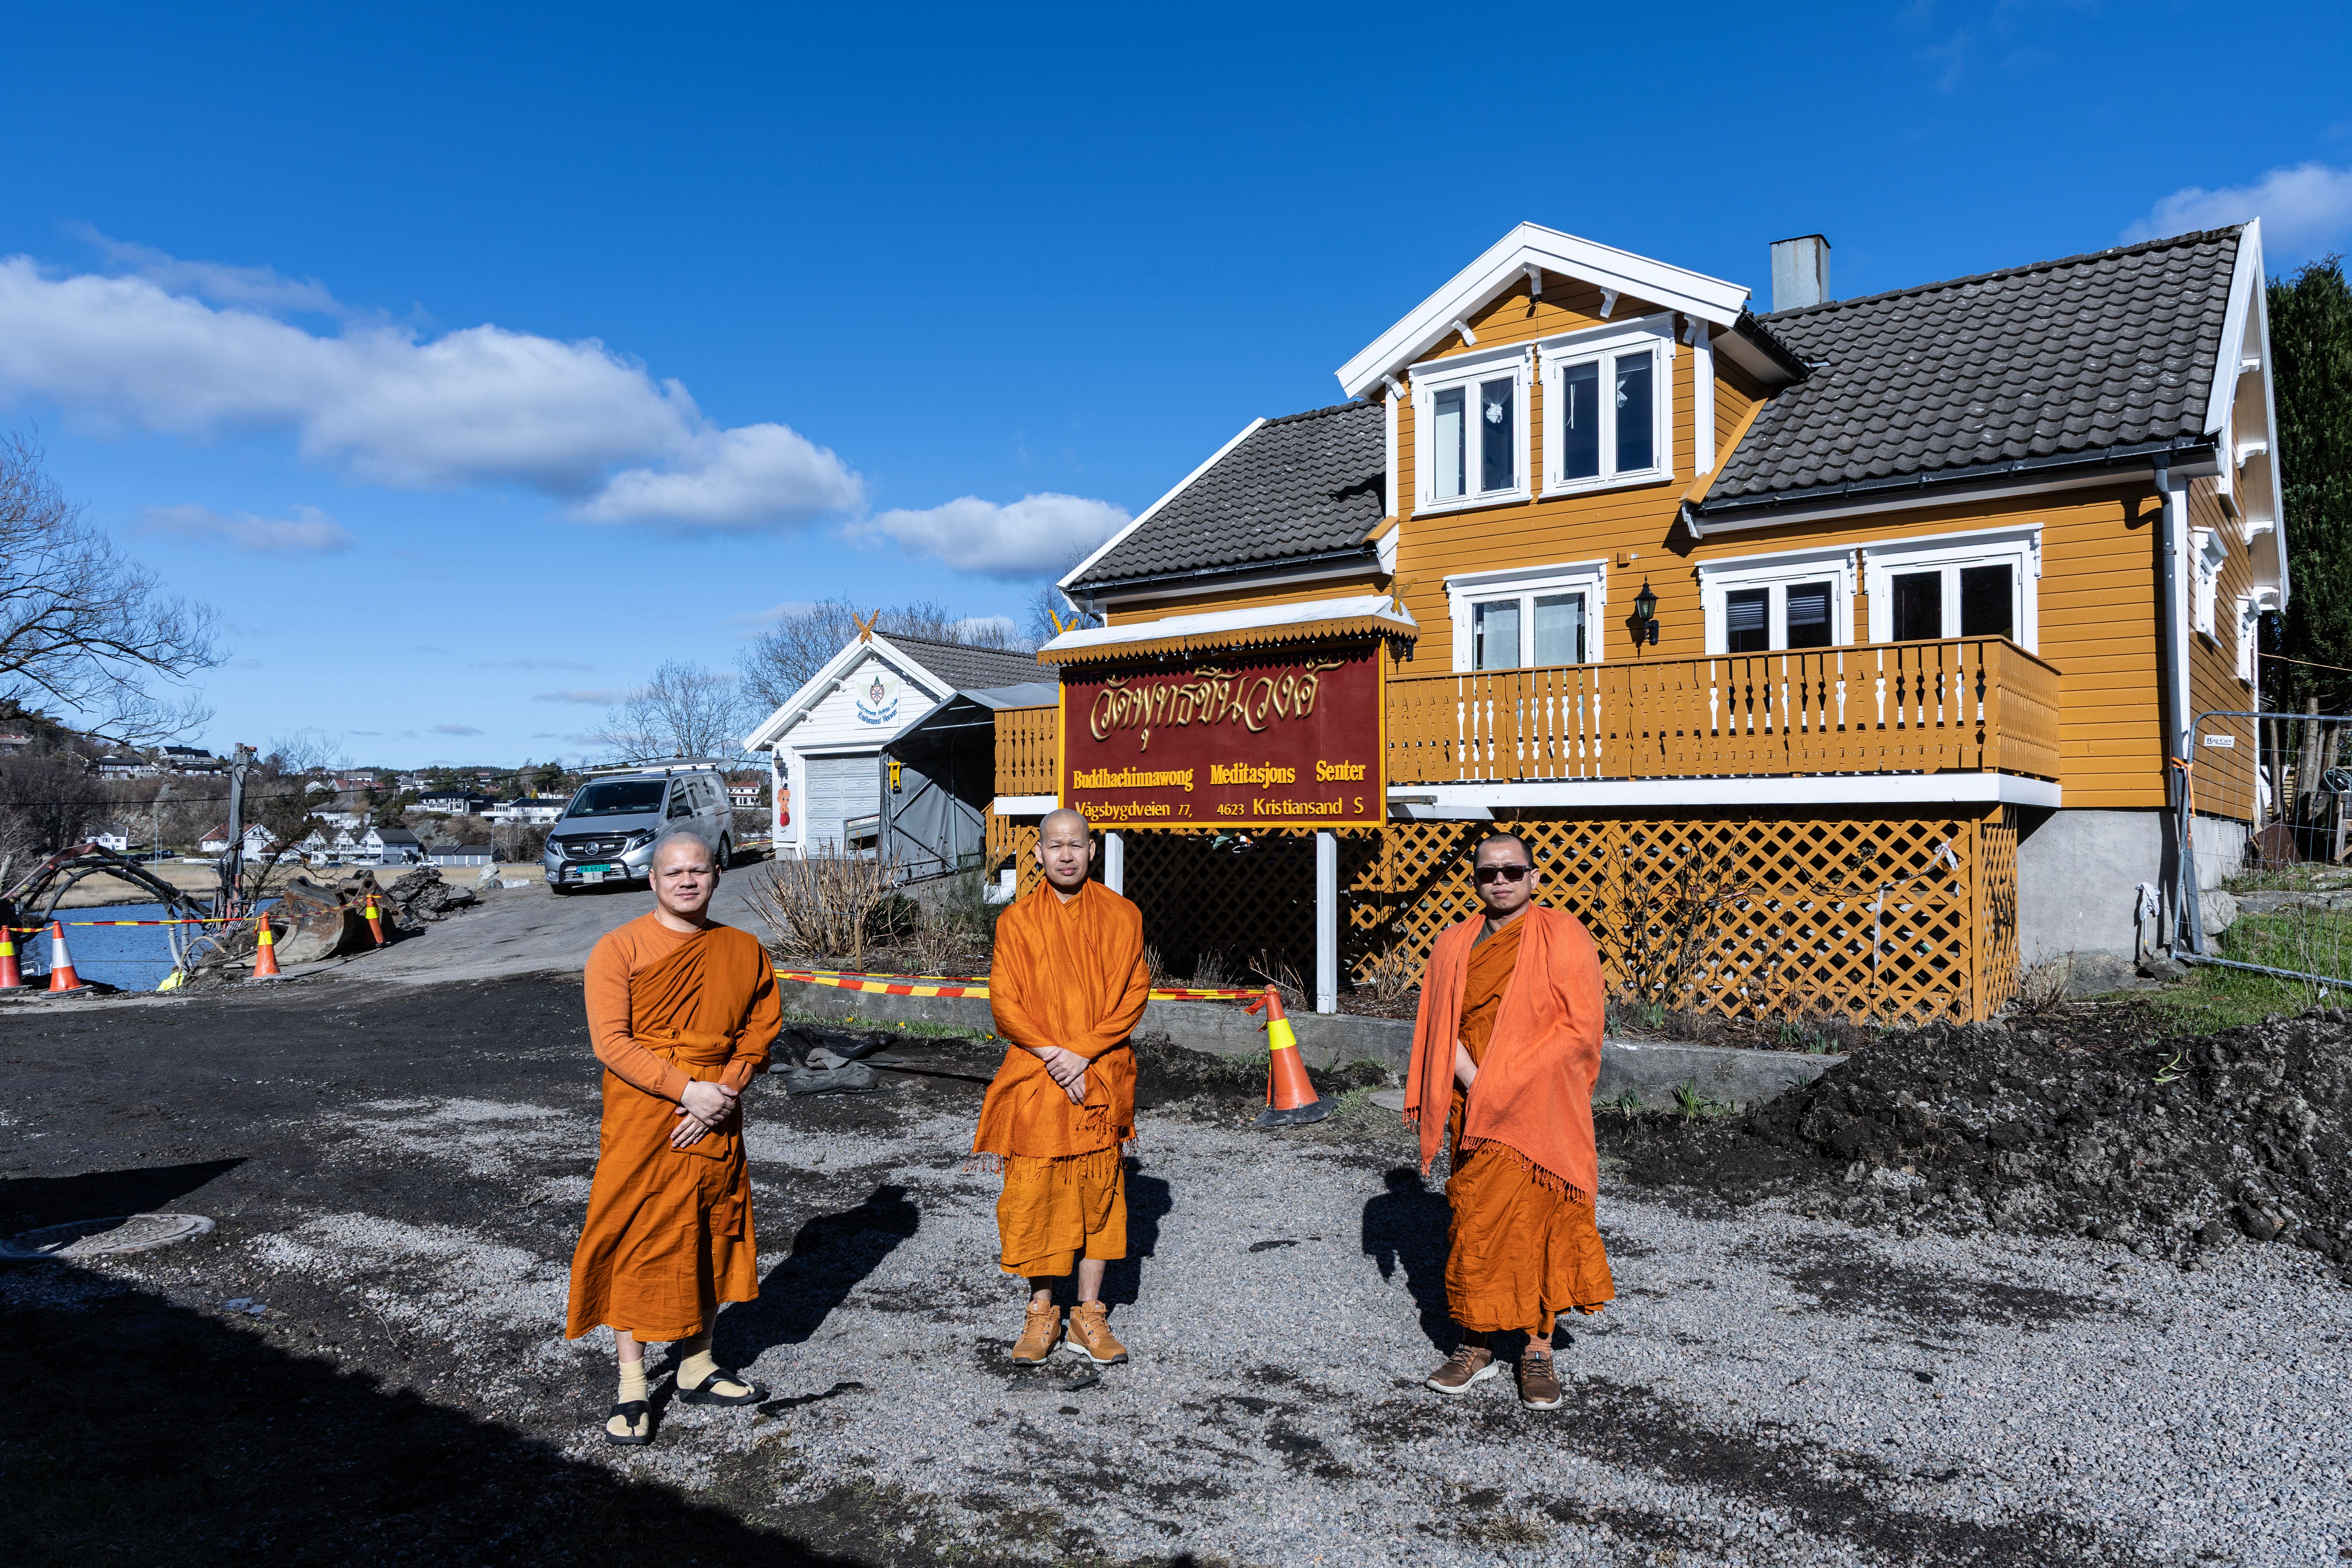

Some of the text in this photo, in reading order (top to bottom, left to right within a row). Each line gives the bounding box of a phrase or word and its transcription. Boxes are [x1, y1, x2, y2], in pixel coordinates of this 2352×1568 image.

[1073, 760, 1366, 792] Buddhachinnawong Meditasjons Senter
[1217, 804, 1245, 816] 4623
[1253, 797, 1342, 815] Kristiansand
[1354, 797, 1364, 814] S
